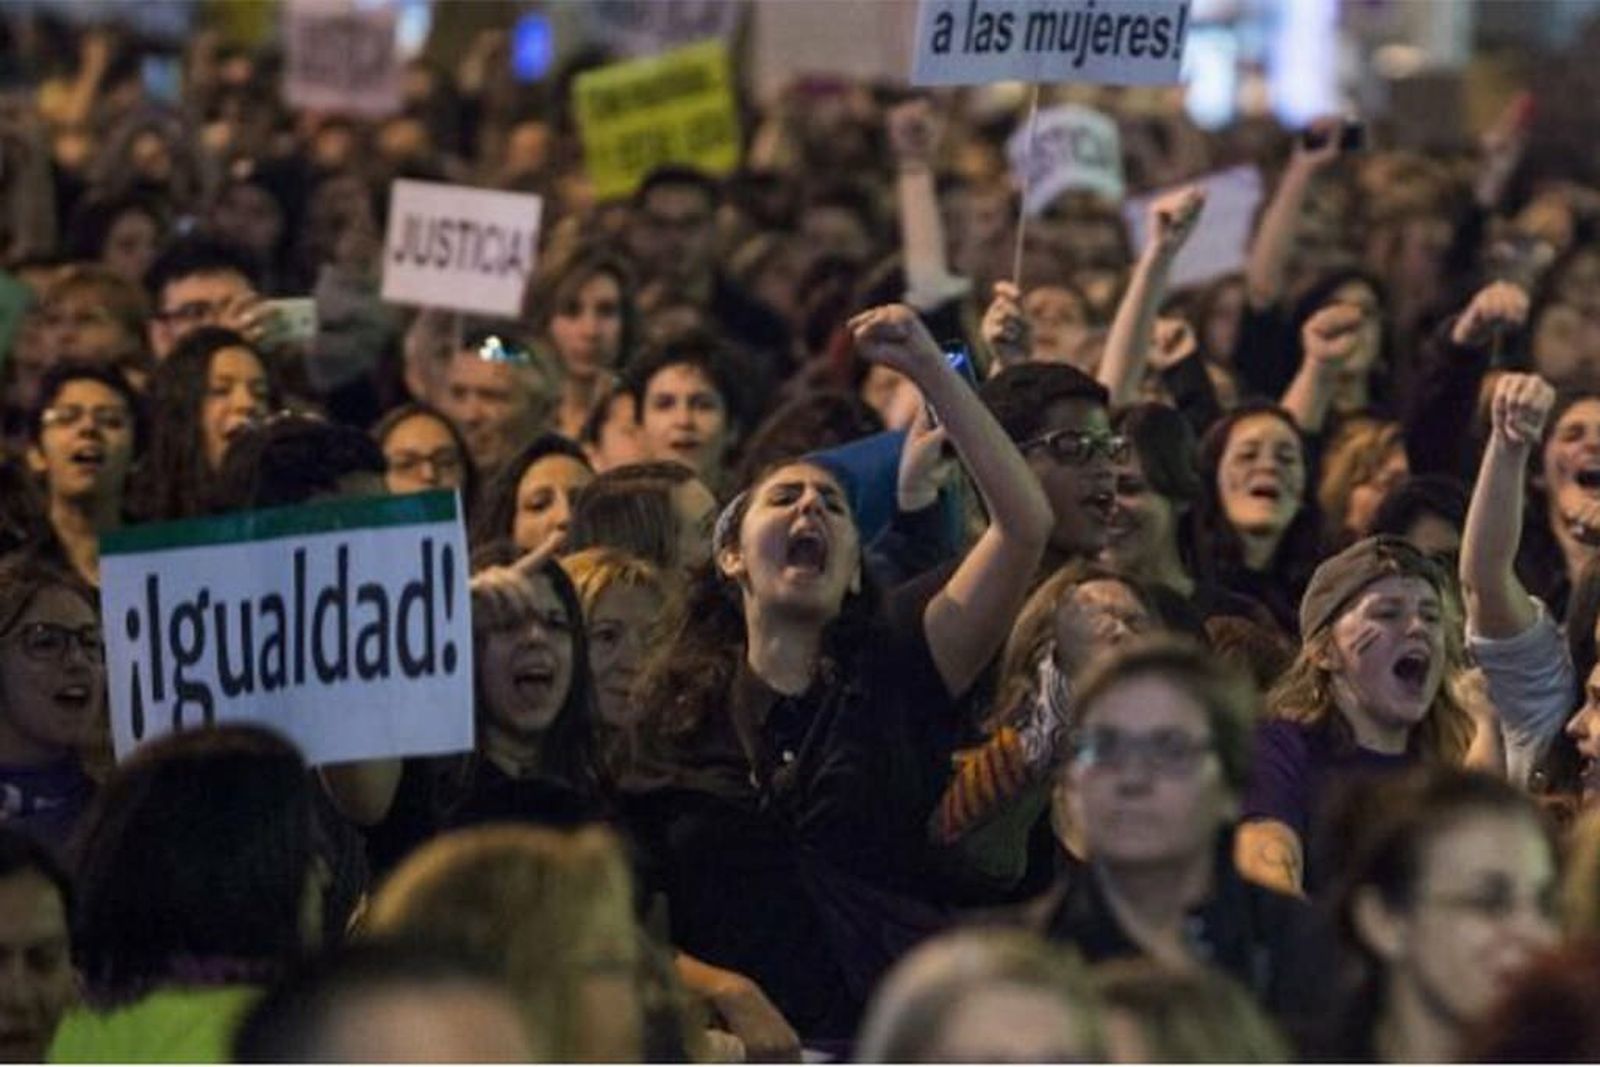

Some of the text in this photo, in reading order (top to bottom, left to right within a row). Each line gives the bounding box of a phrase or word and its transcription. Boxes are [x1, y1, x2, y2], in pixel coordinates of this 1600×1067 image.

[931, 0, 1188, 68] a las mujeres!
[126, 536, 457, 741] ¡Igualdad!
